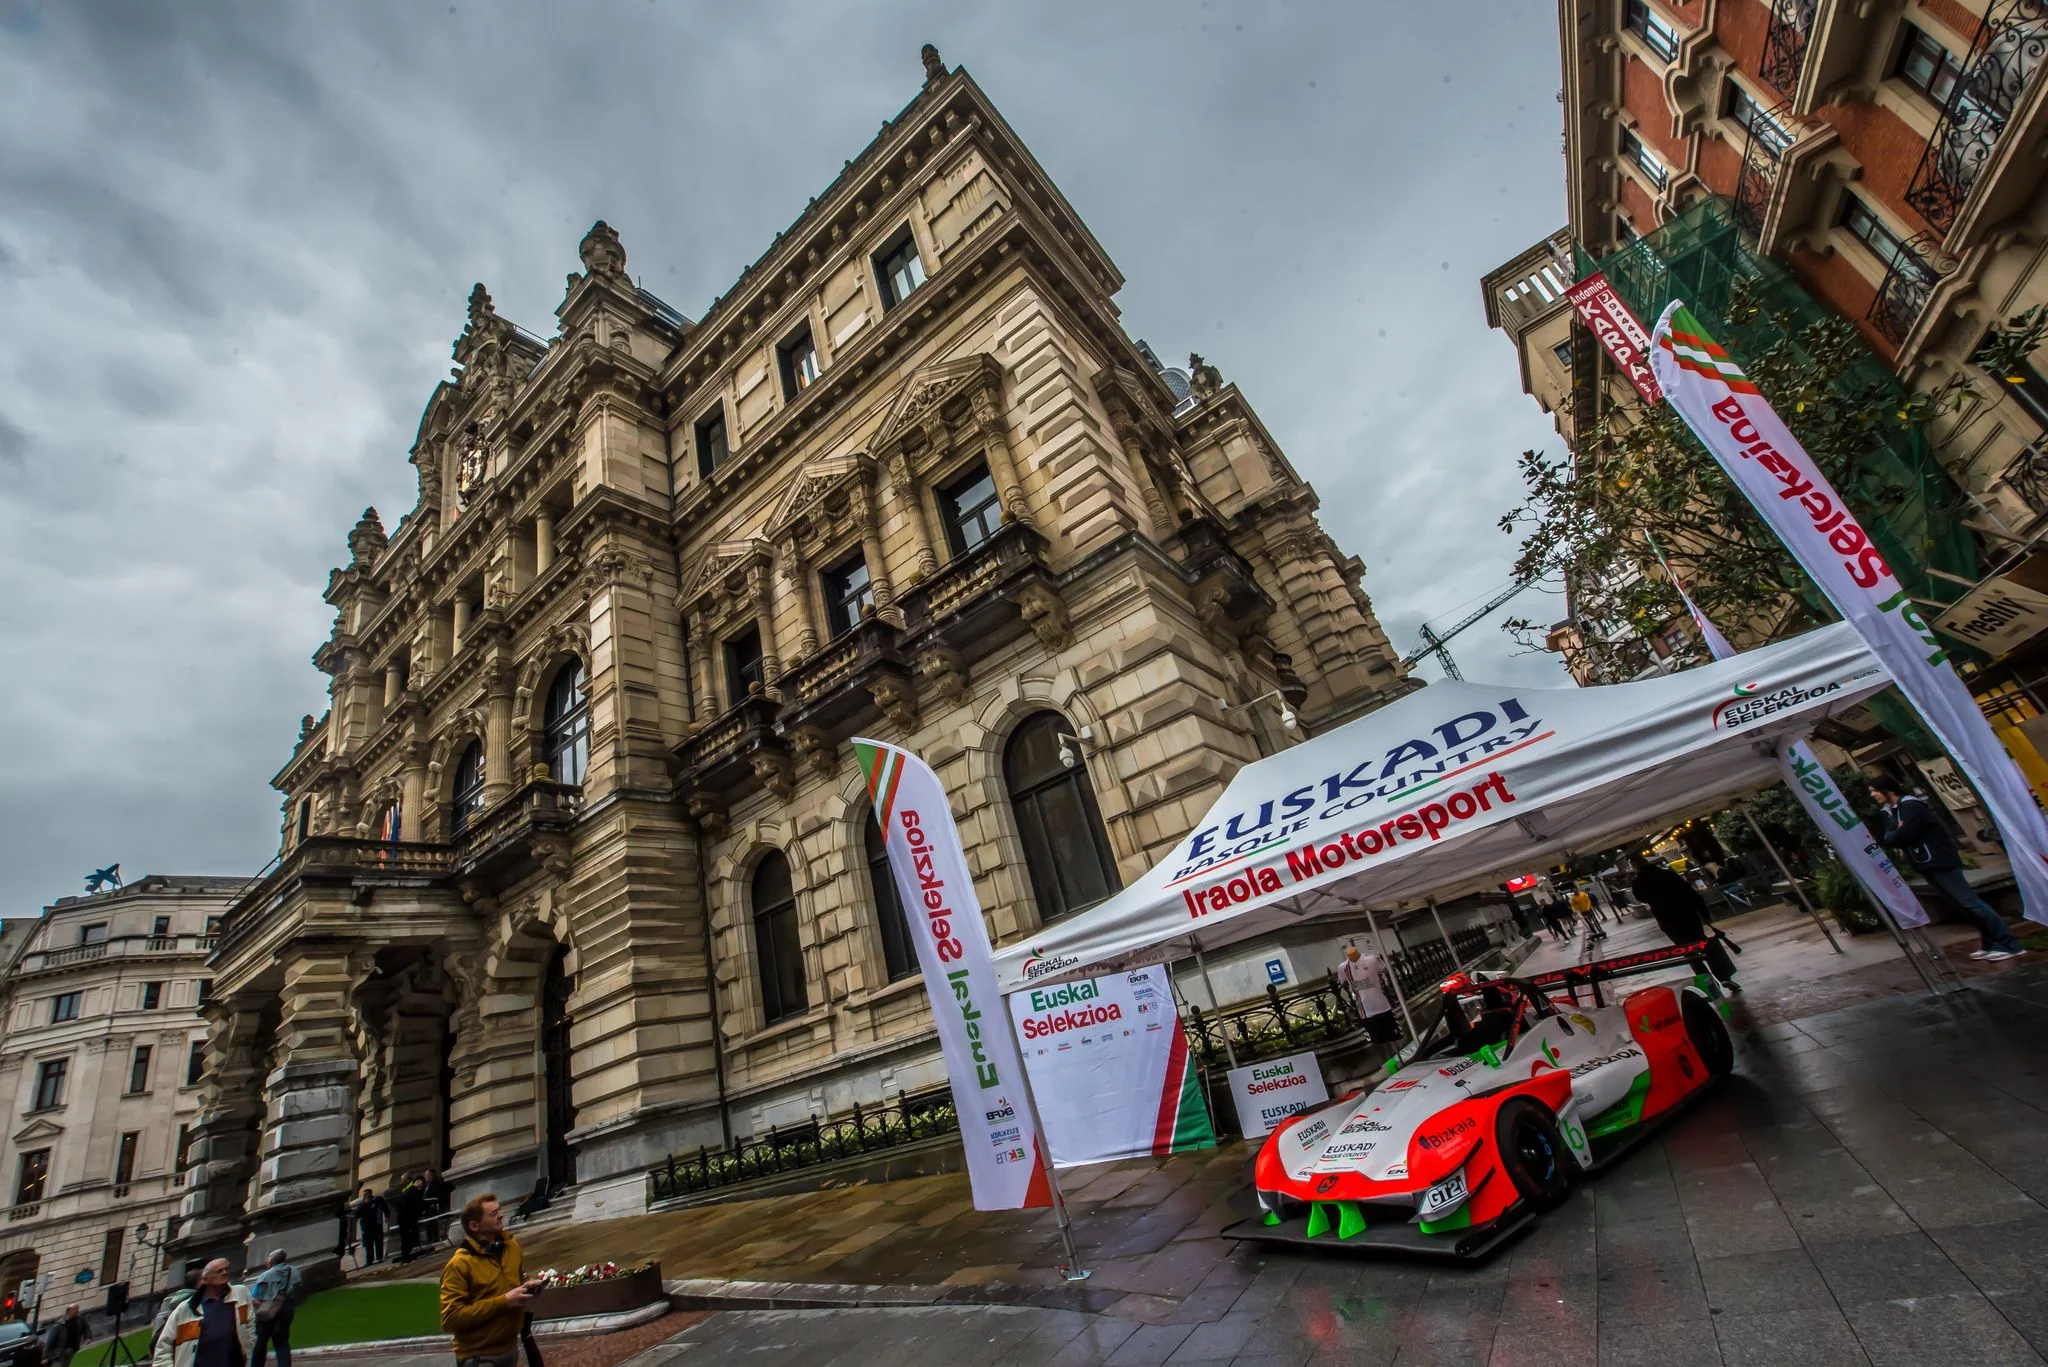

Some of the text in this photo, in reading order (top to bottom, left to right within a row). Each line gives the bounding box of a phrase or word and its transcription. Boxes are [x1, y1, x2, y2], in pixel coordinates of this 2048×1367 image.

[1570, 279, 1607, 306] Andamios
[1579, 301, 1648, 380] KARPA
[1711, 395, 1892, 588] Selekzioa
[1944, 597, 2036, 641] Freshly
[1724, 686, 1804, 719] EUSKAL
[1726, 682, 1841, 729] SELEKZIOA
[1186, 698, 1531, 863] EUSKADI
[1172, 719, 1542, 881] BASQUE COUNTRY
[1182, 771, 1516, 919] Iraola Motorsport
[1028, 956, 1063, 974] EUSKAL
[1028, 957, 1079, 980] SELEKZIOA
[1129, 973, 1149, 984] EKFB
[1030, 978, 1099, 1012] Euskal
[1022, 1003, 1122, 1040] Selekzioa
[1247, 1074, 1307, 1095] Selekzioa
[1252, 1062, 1294, 1081] Euskal
[1261, 1101, 1308, 1119] EUSKADI
[1297, 1120, 1326, 1141] EUSKADI
[1429, 1117, 1476, 1148] Bizkaia
[1326, 1142, 1376, 1154] EUSKADI
